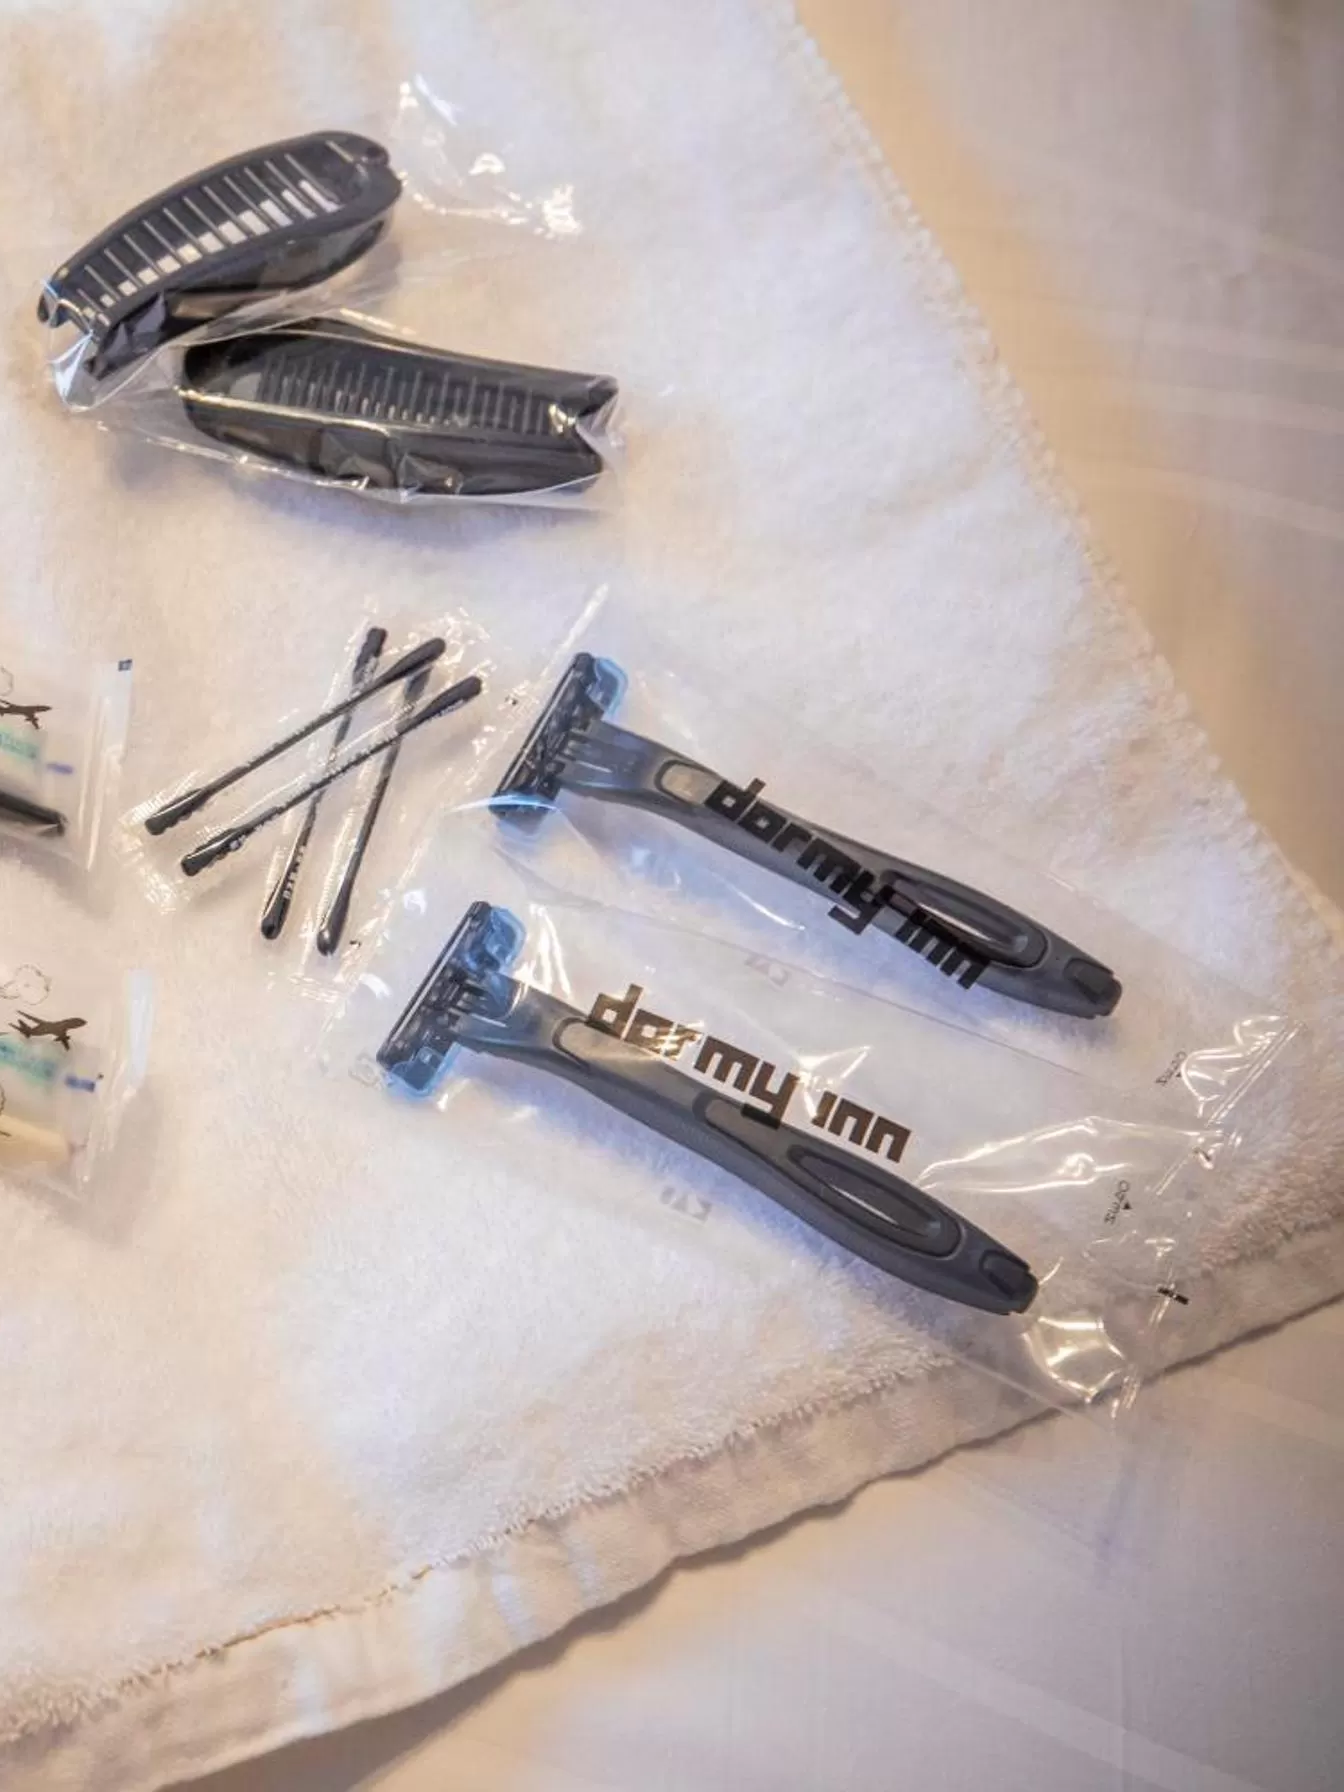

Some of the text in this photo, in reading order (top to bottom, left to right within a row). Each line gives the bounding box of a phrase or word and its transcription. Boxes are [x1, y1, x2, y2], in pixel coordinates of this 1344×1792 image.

[704, 777, 991, 990] dormy inn
[584, 983, 912, 1164] dormy inn
